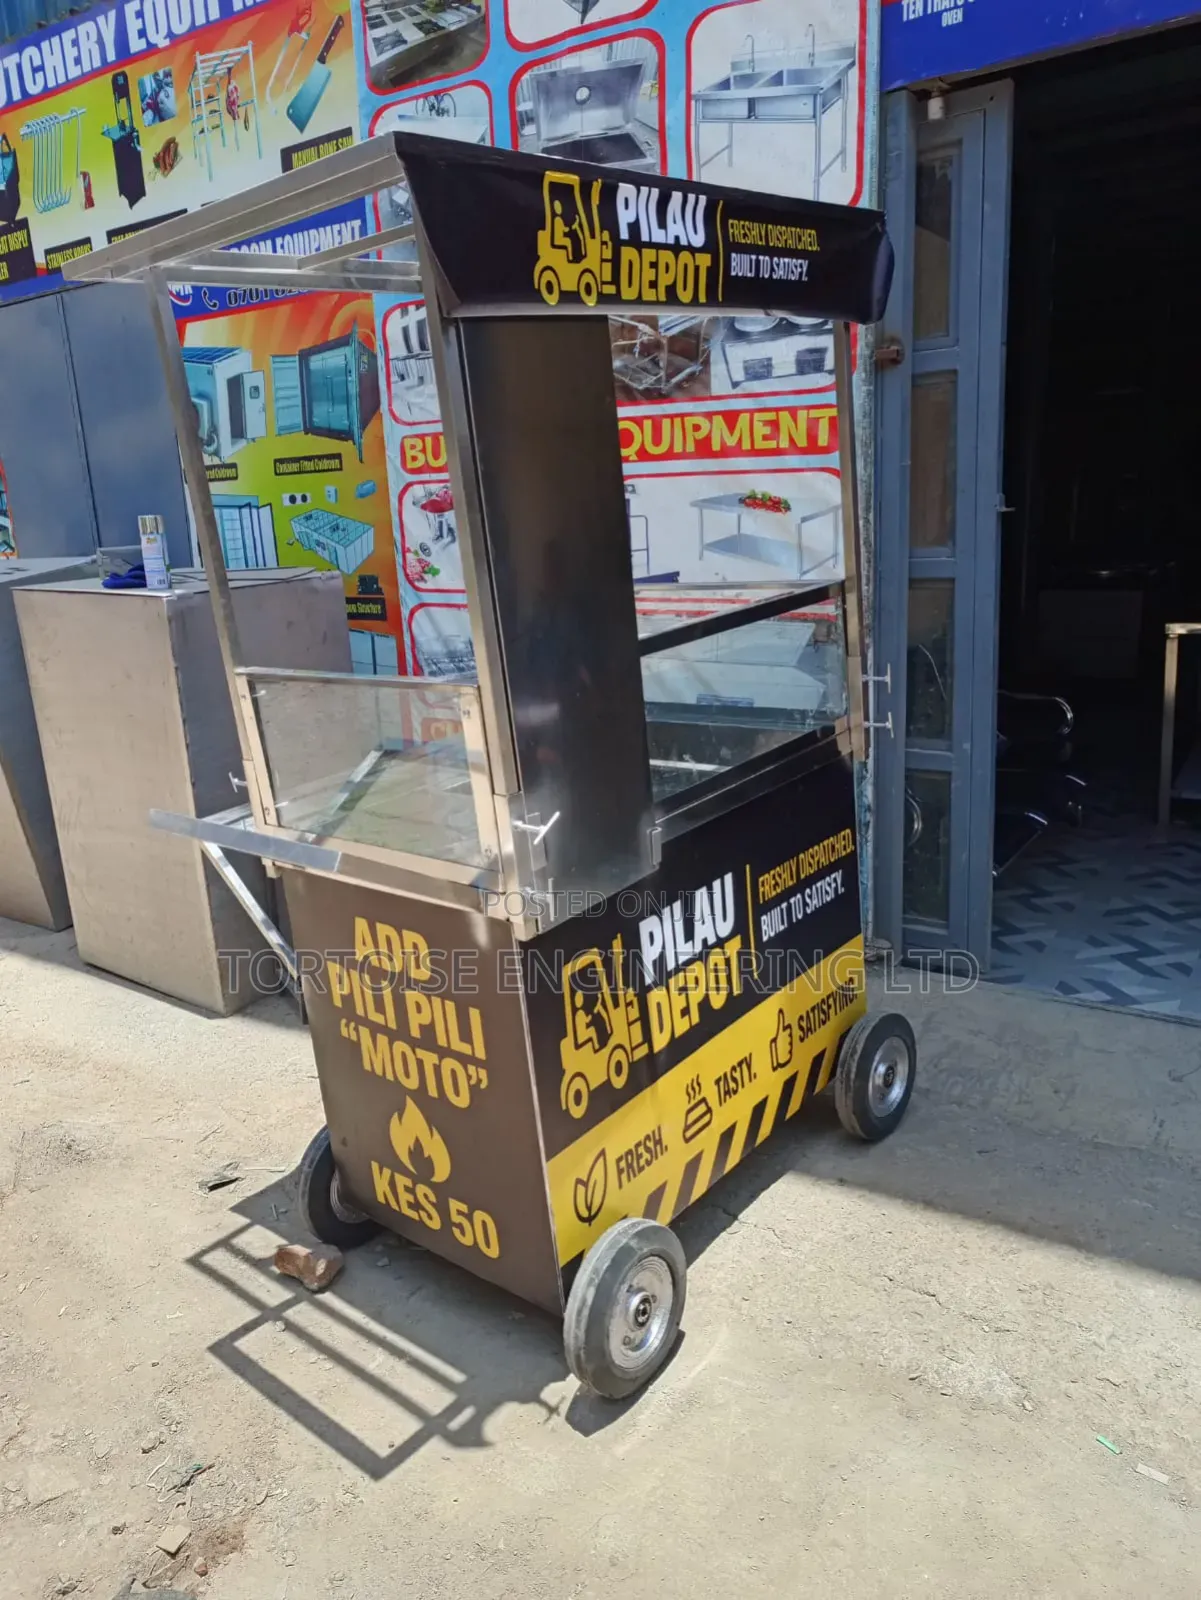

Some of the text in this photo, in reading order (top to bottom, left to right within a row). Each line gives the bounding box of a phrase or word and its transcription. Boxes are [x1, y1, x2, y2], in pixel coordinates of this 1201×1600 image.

[124, 0, 267, 54] EQUI
[942, 7, 963, 27] OVEN
[276, 220, 361, 256] EQUIPMENT
[616, 182, 707, 248] PILAU
[728, 219, 820, 252] FRESHLY DISPATCHED.
[620, 246, 711, 303] DEPOT
[730, 252, 809, 282] BUILT TO SATISFY.
[403, 407, 838, 469] BU QUIPMENT
[758, 828, 856, 904] FRESHLY DISPATCHED.
[638, 871, 736, 986] PILAU
[760, 869, 845, 943] BUILT TO SATISFY.
[354, 916, 431, 982] ADD
[326, 960, 487, 1061] PILI PILI
[647, 934, 743, 1055] DEPOT
[797, 977, 859, 1043] SATISFYING.
[714, 1052, 757, 1108] TASTY.
[615, 1125, 669, 1190] FRESH.
[371, 1161, 500, 1260] KES 50
